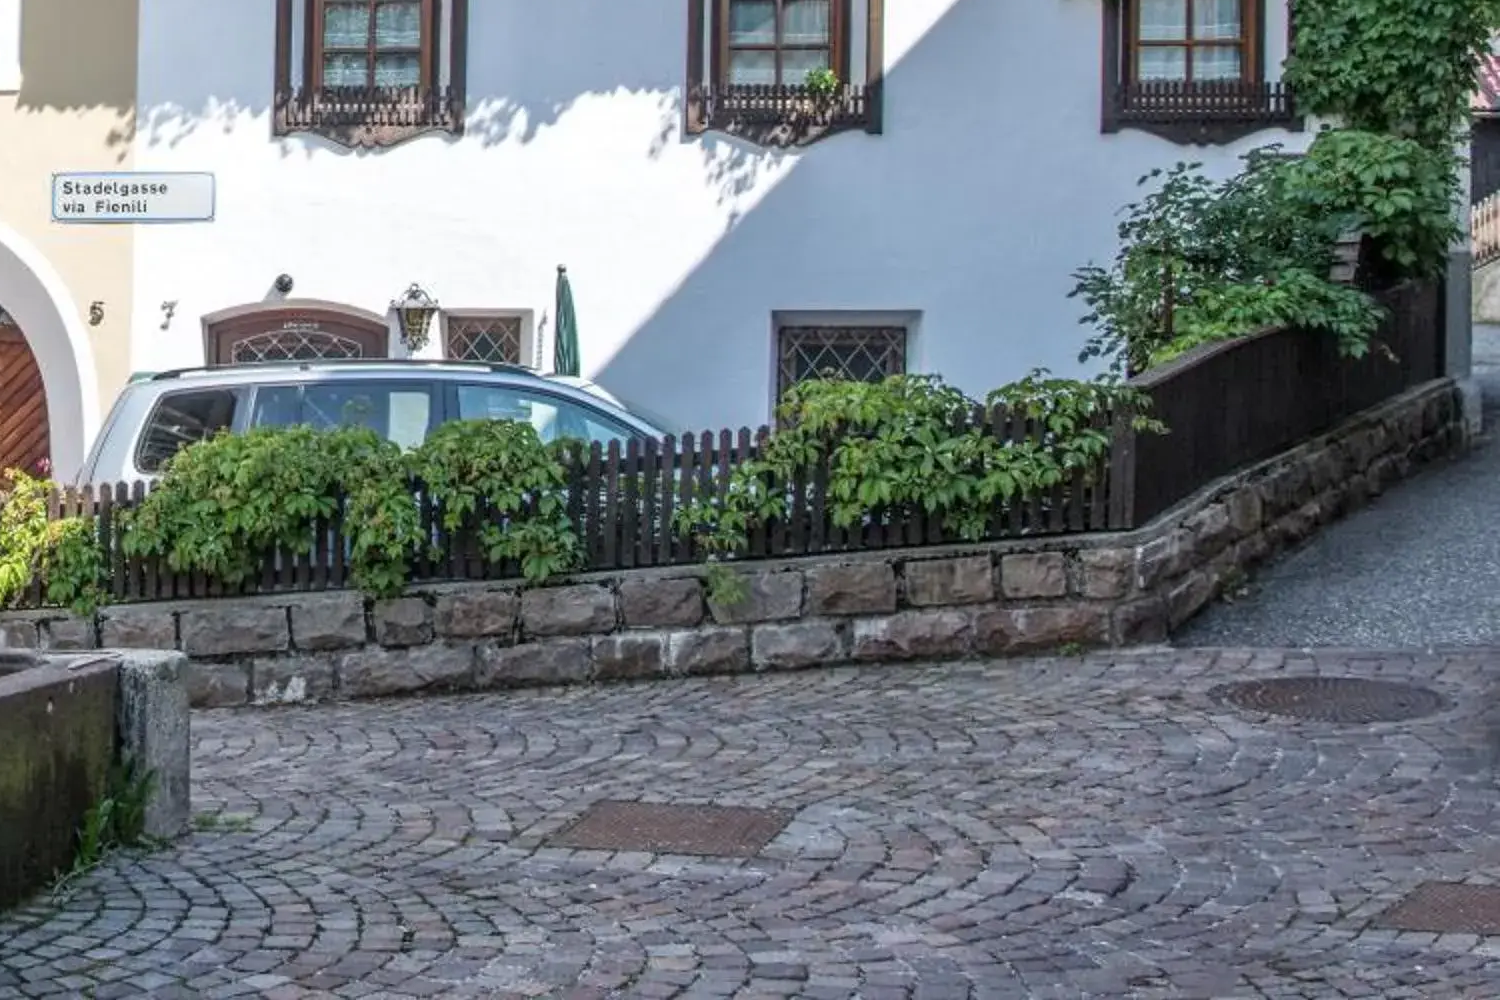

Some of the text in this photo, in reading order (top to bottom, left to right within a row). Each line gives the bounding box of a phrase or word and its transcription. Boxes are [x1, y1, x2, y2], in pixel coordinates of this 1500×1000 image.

[63, 181, 167, 197] Stadelgasse
[63, 200, 85, 213] via
[89, 300, 105, 326] 5
[160, 300, 179, 331] 7
